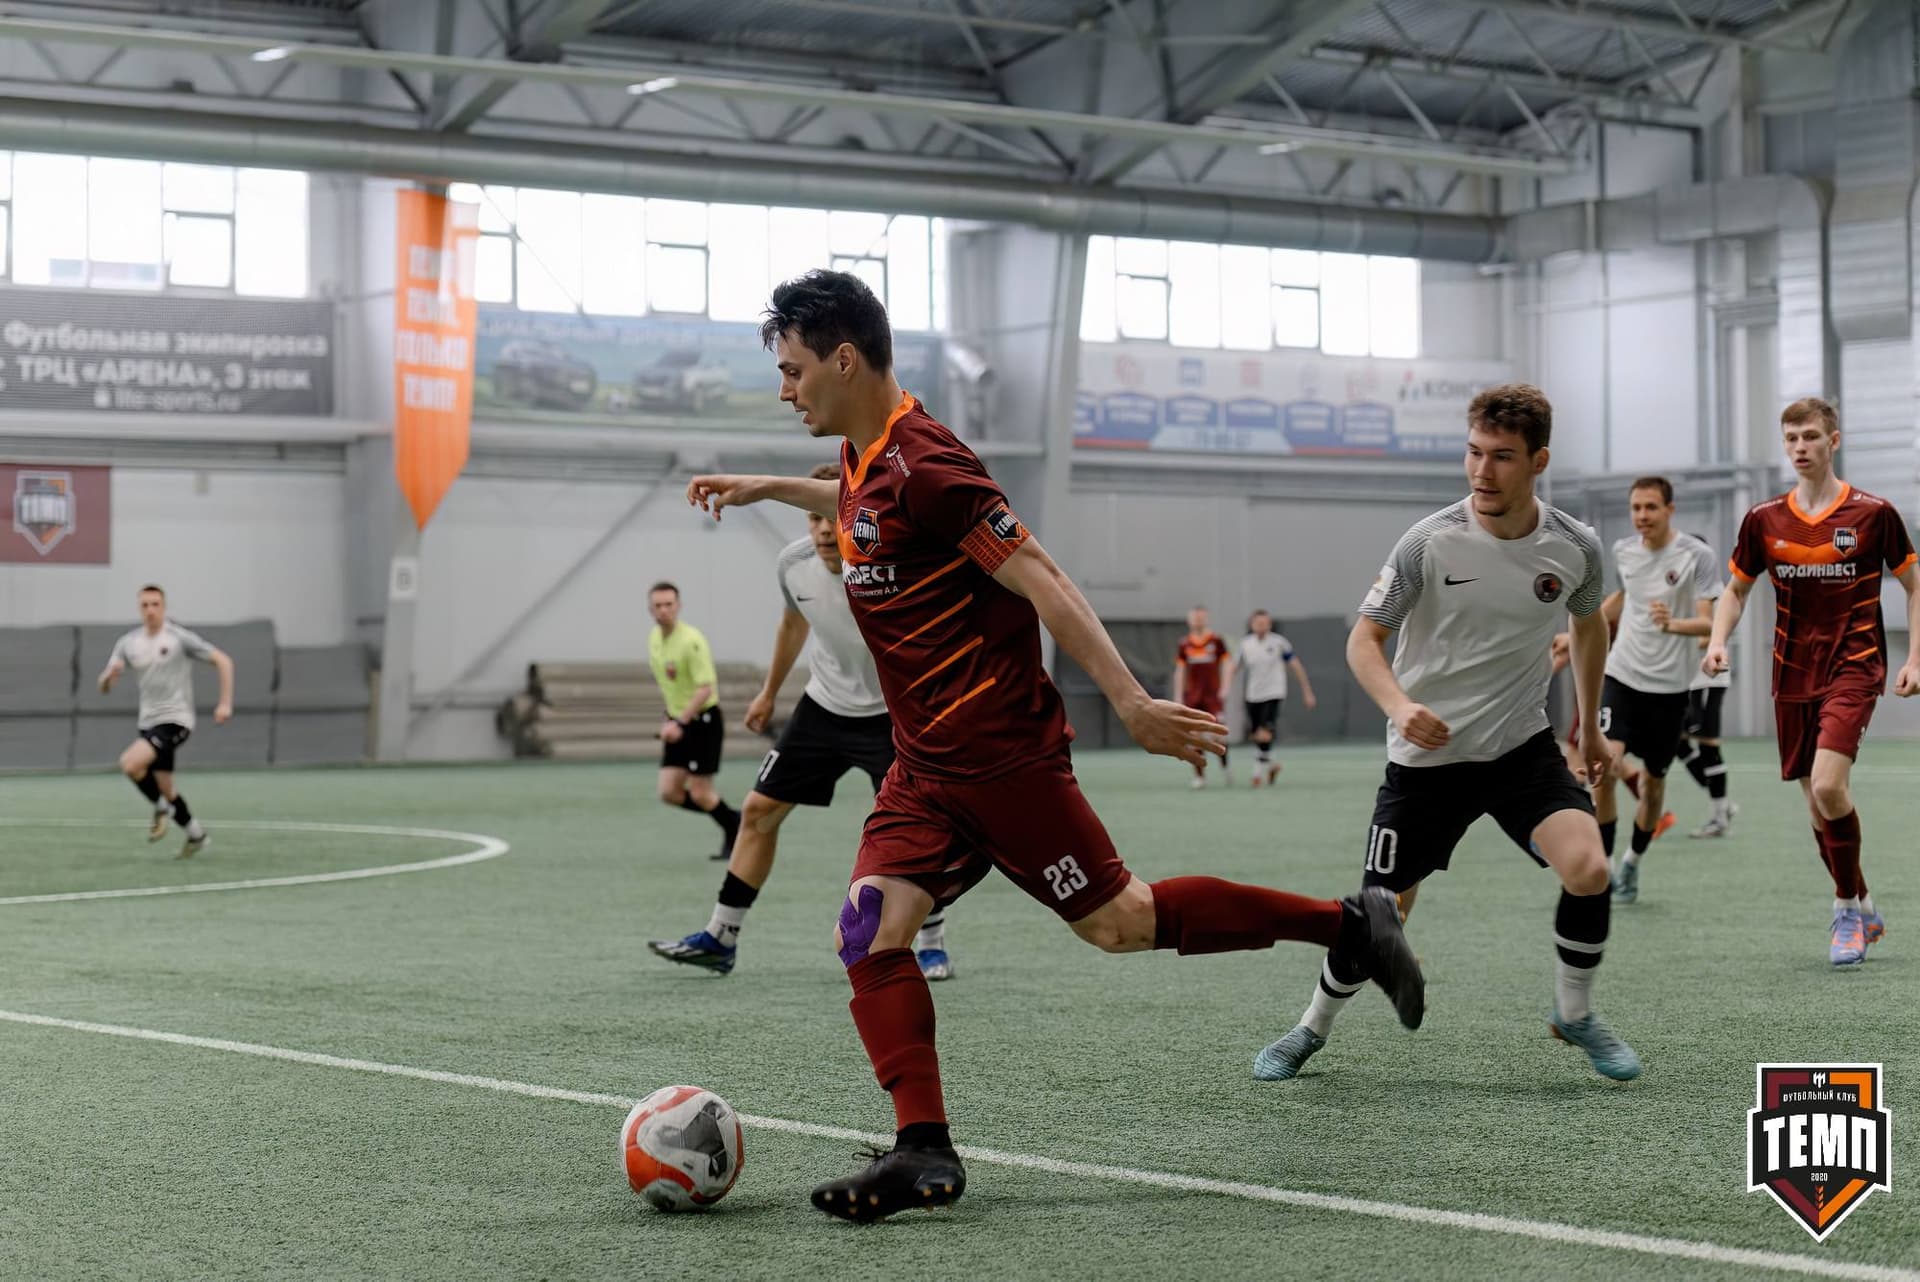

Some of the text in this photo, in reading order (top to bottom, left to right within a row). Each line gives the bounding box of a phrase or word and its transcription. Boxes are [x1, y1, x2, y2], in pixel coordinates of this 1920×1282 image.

[4, 319, 328, 361] Футбольная экипировка
[16, 355, 79, 388] ТРЦ
[81, 357, 222, 392] «АРЕНА»,
[248, 367, 312, 390] этаж
[854, 521, 877, 542] ТЕМП
[1365, 824, 1398, 875] 10
[1043, 855, 1089, 901] 23
